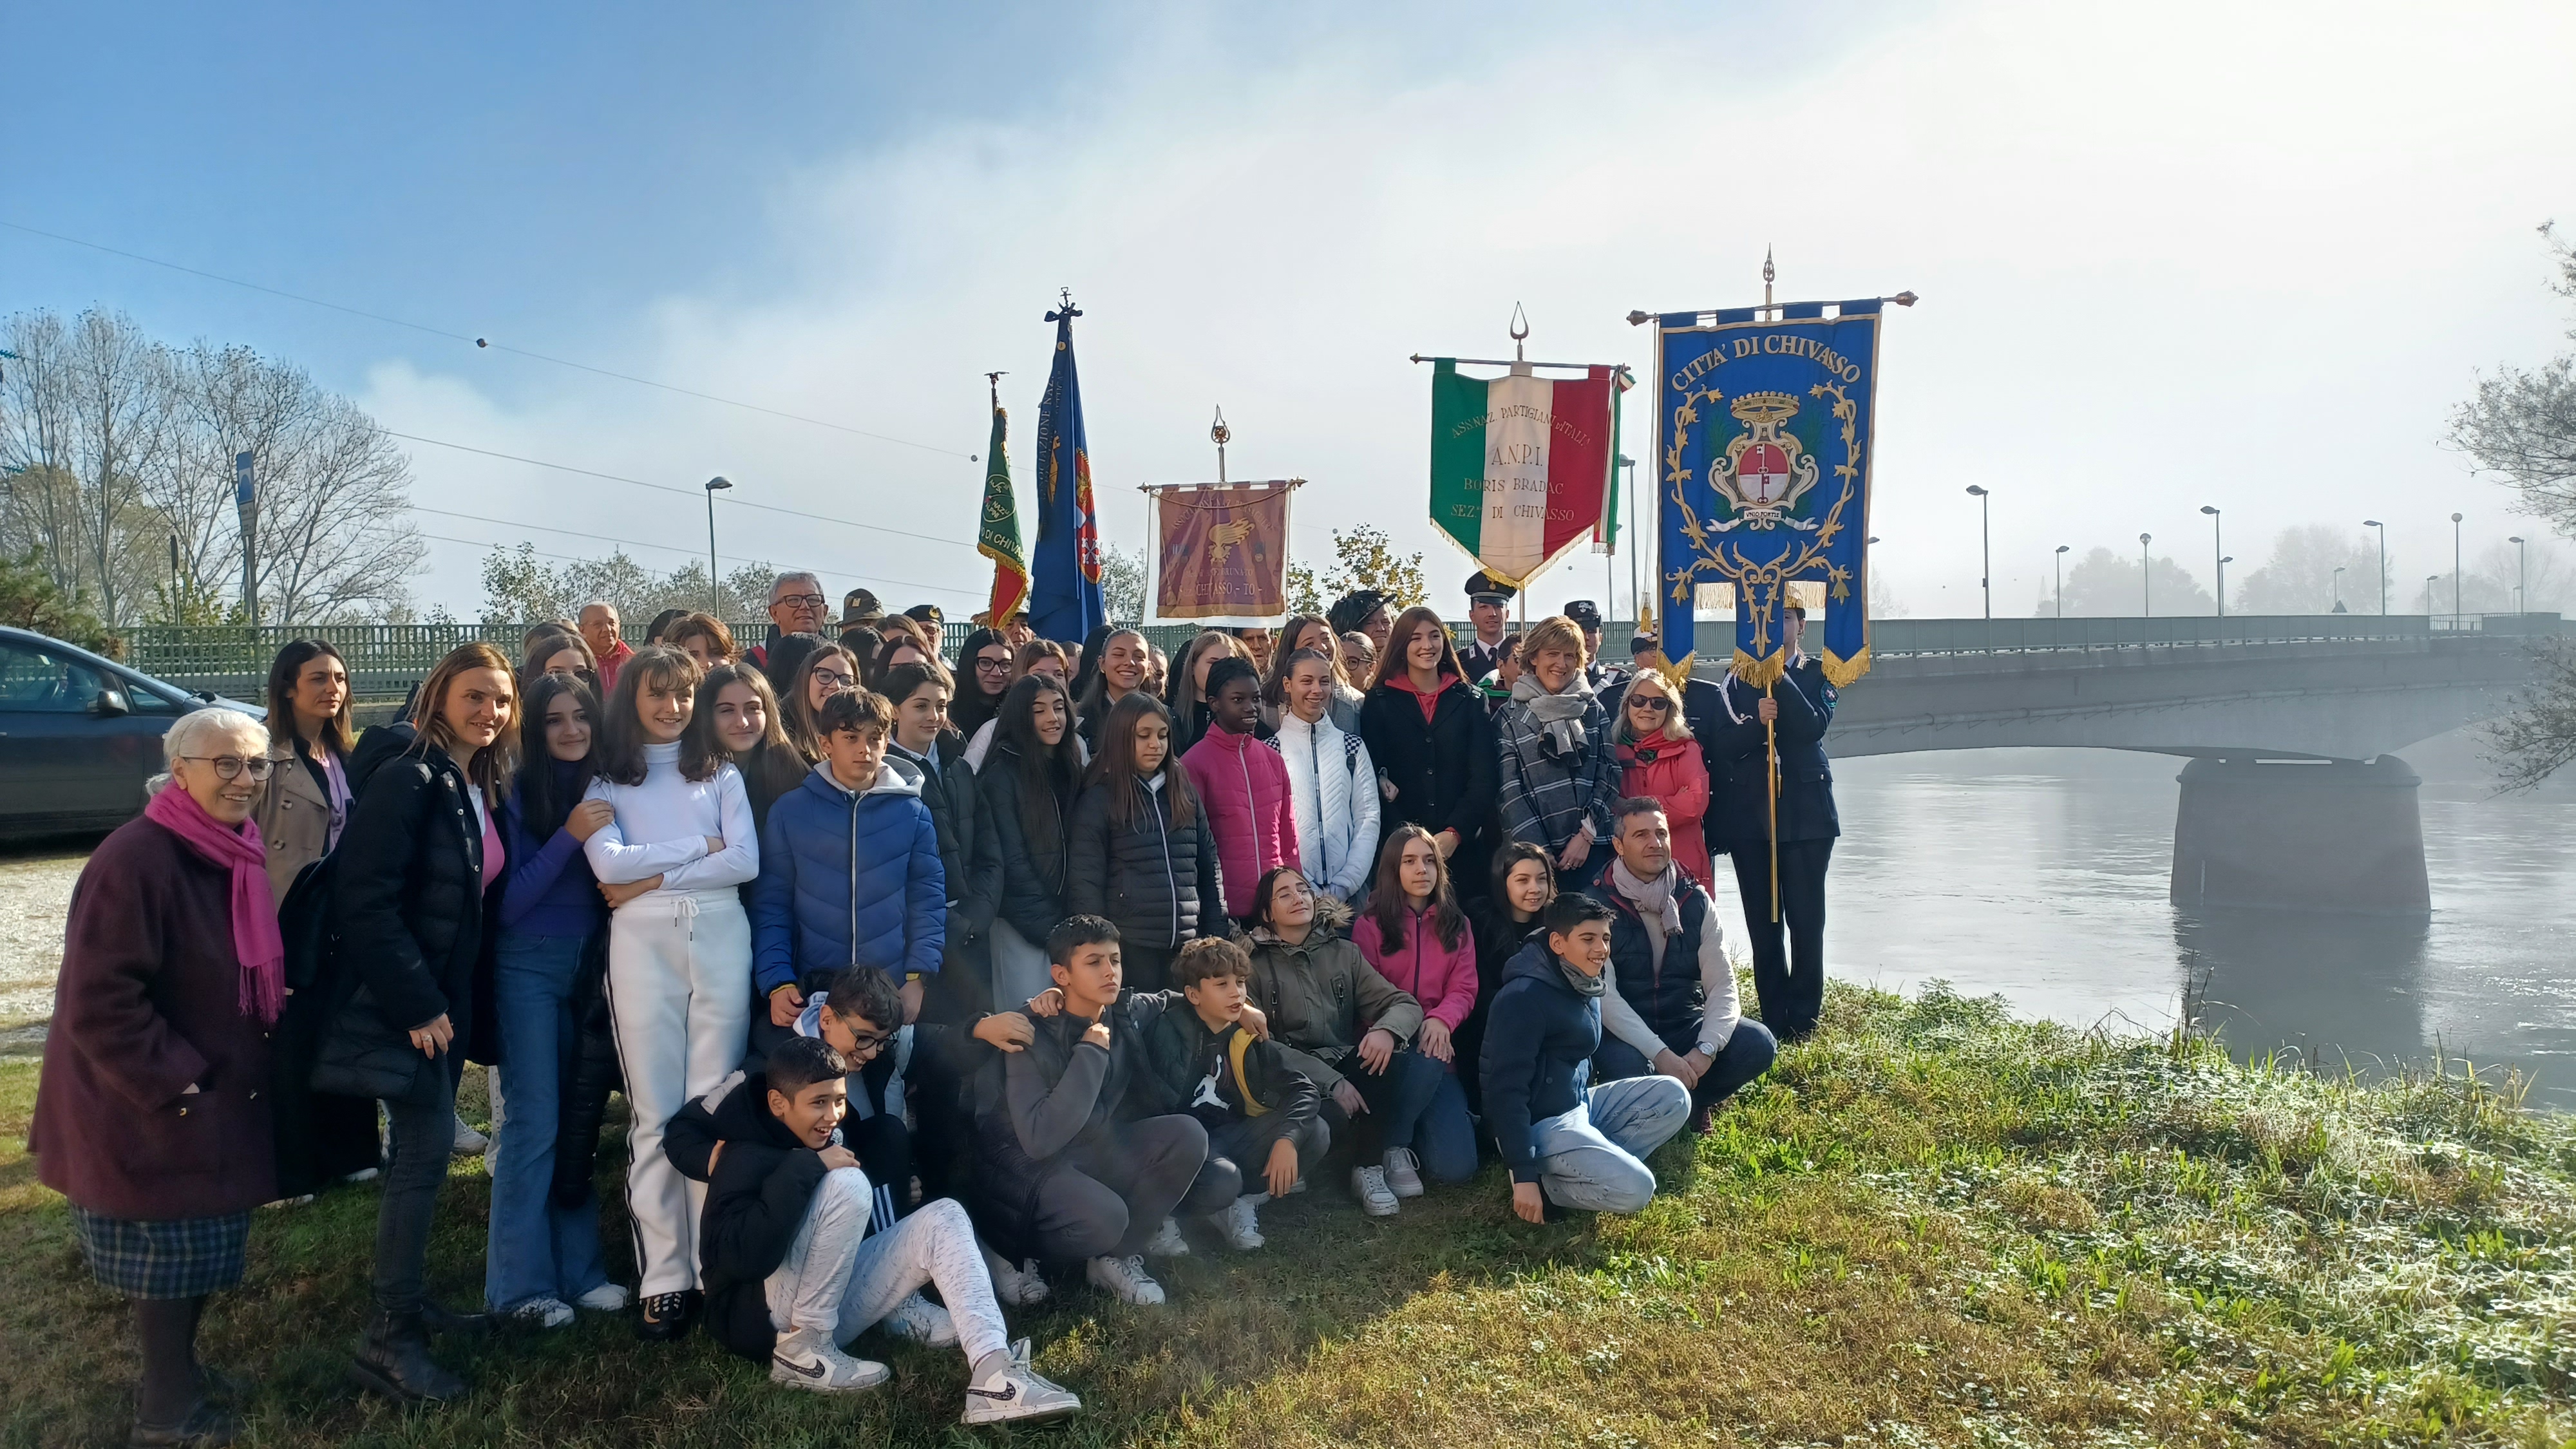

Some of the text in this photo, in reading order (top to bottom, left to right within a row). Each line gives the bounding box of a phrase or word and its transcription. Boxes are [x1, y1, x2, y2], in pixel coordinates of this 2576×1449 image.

[1671, 334, 1861, 391] CITTA' DI CHIVASSO
[1501, 405, 1557, 426] PARTIGIANI
[1491, 444, 1543, 466] A.N.P.I.
[1464, 478, 1564, 495] BORIS BRADAC
[1492, 506, 1503, 518] DI
[1513, 505, 1575, 521] CHIVASSO
